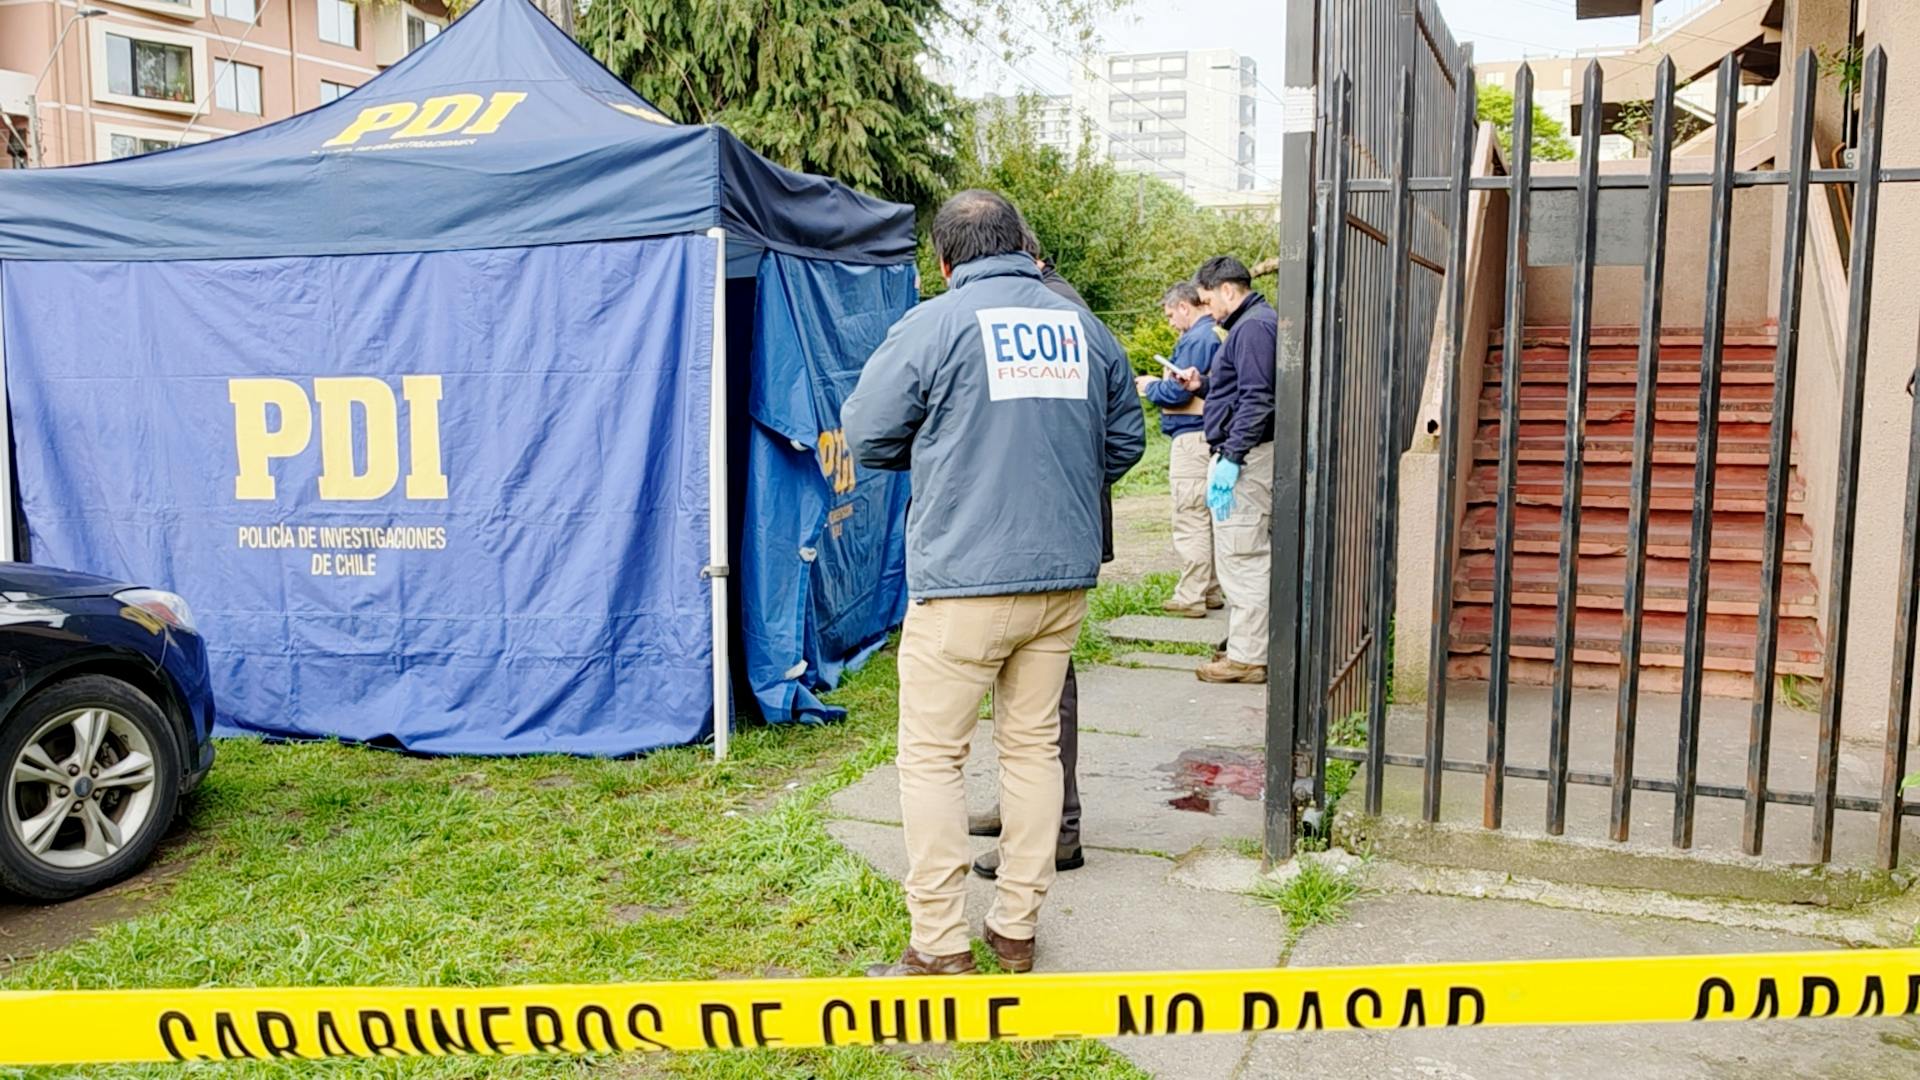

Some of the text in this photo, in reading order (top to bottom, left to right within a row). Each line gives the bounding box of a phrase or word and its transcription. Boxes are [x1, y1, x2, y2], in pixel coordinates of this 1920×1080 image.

[322, 92, 528, 147] PDI
[991, 323, 1080, 362] ECOH
[228, 375, 448, 500] PDI
[239, 523, 446, 549] POLICÍA DE INVESTIGACIONES
[311, 553, 376, 576] DE CHILE
[159, 1003, 672, 1060] CARABINEROS
[700, 1002, 783, 1048] DE
[822, 997, 1020, 1047] CHILE
[1118, 992, 1204, 1035] NO
